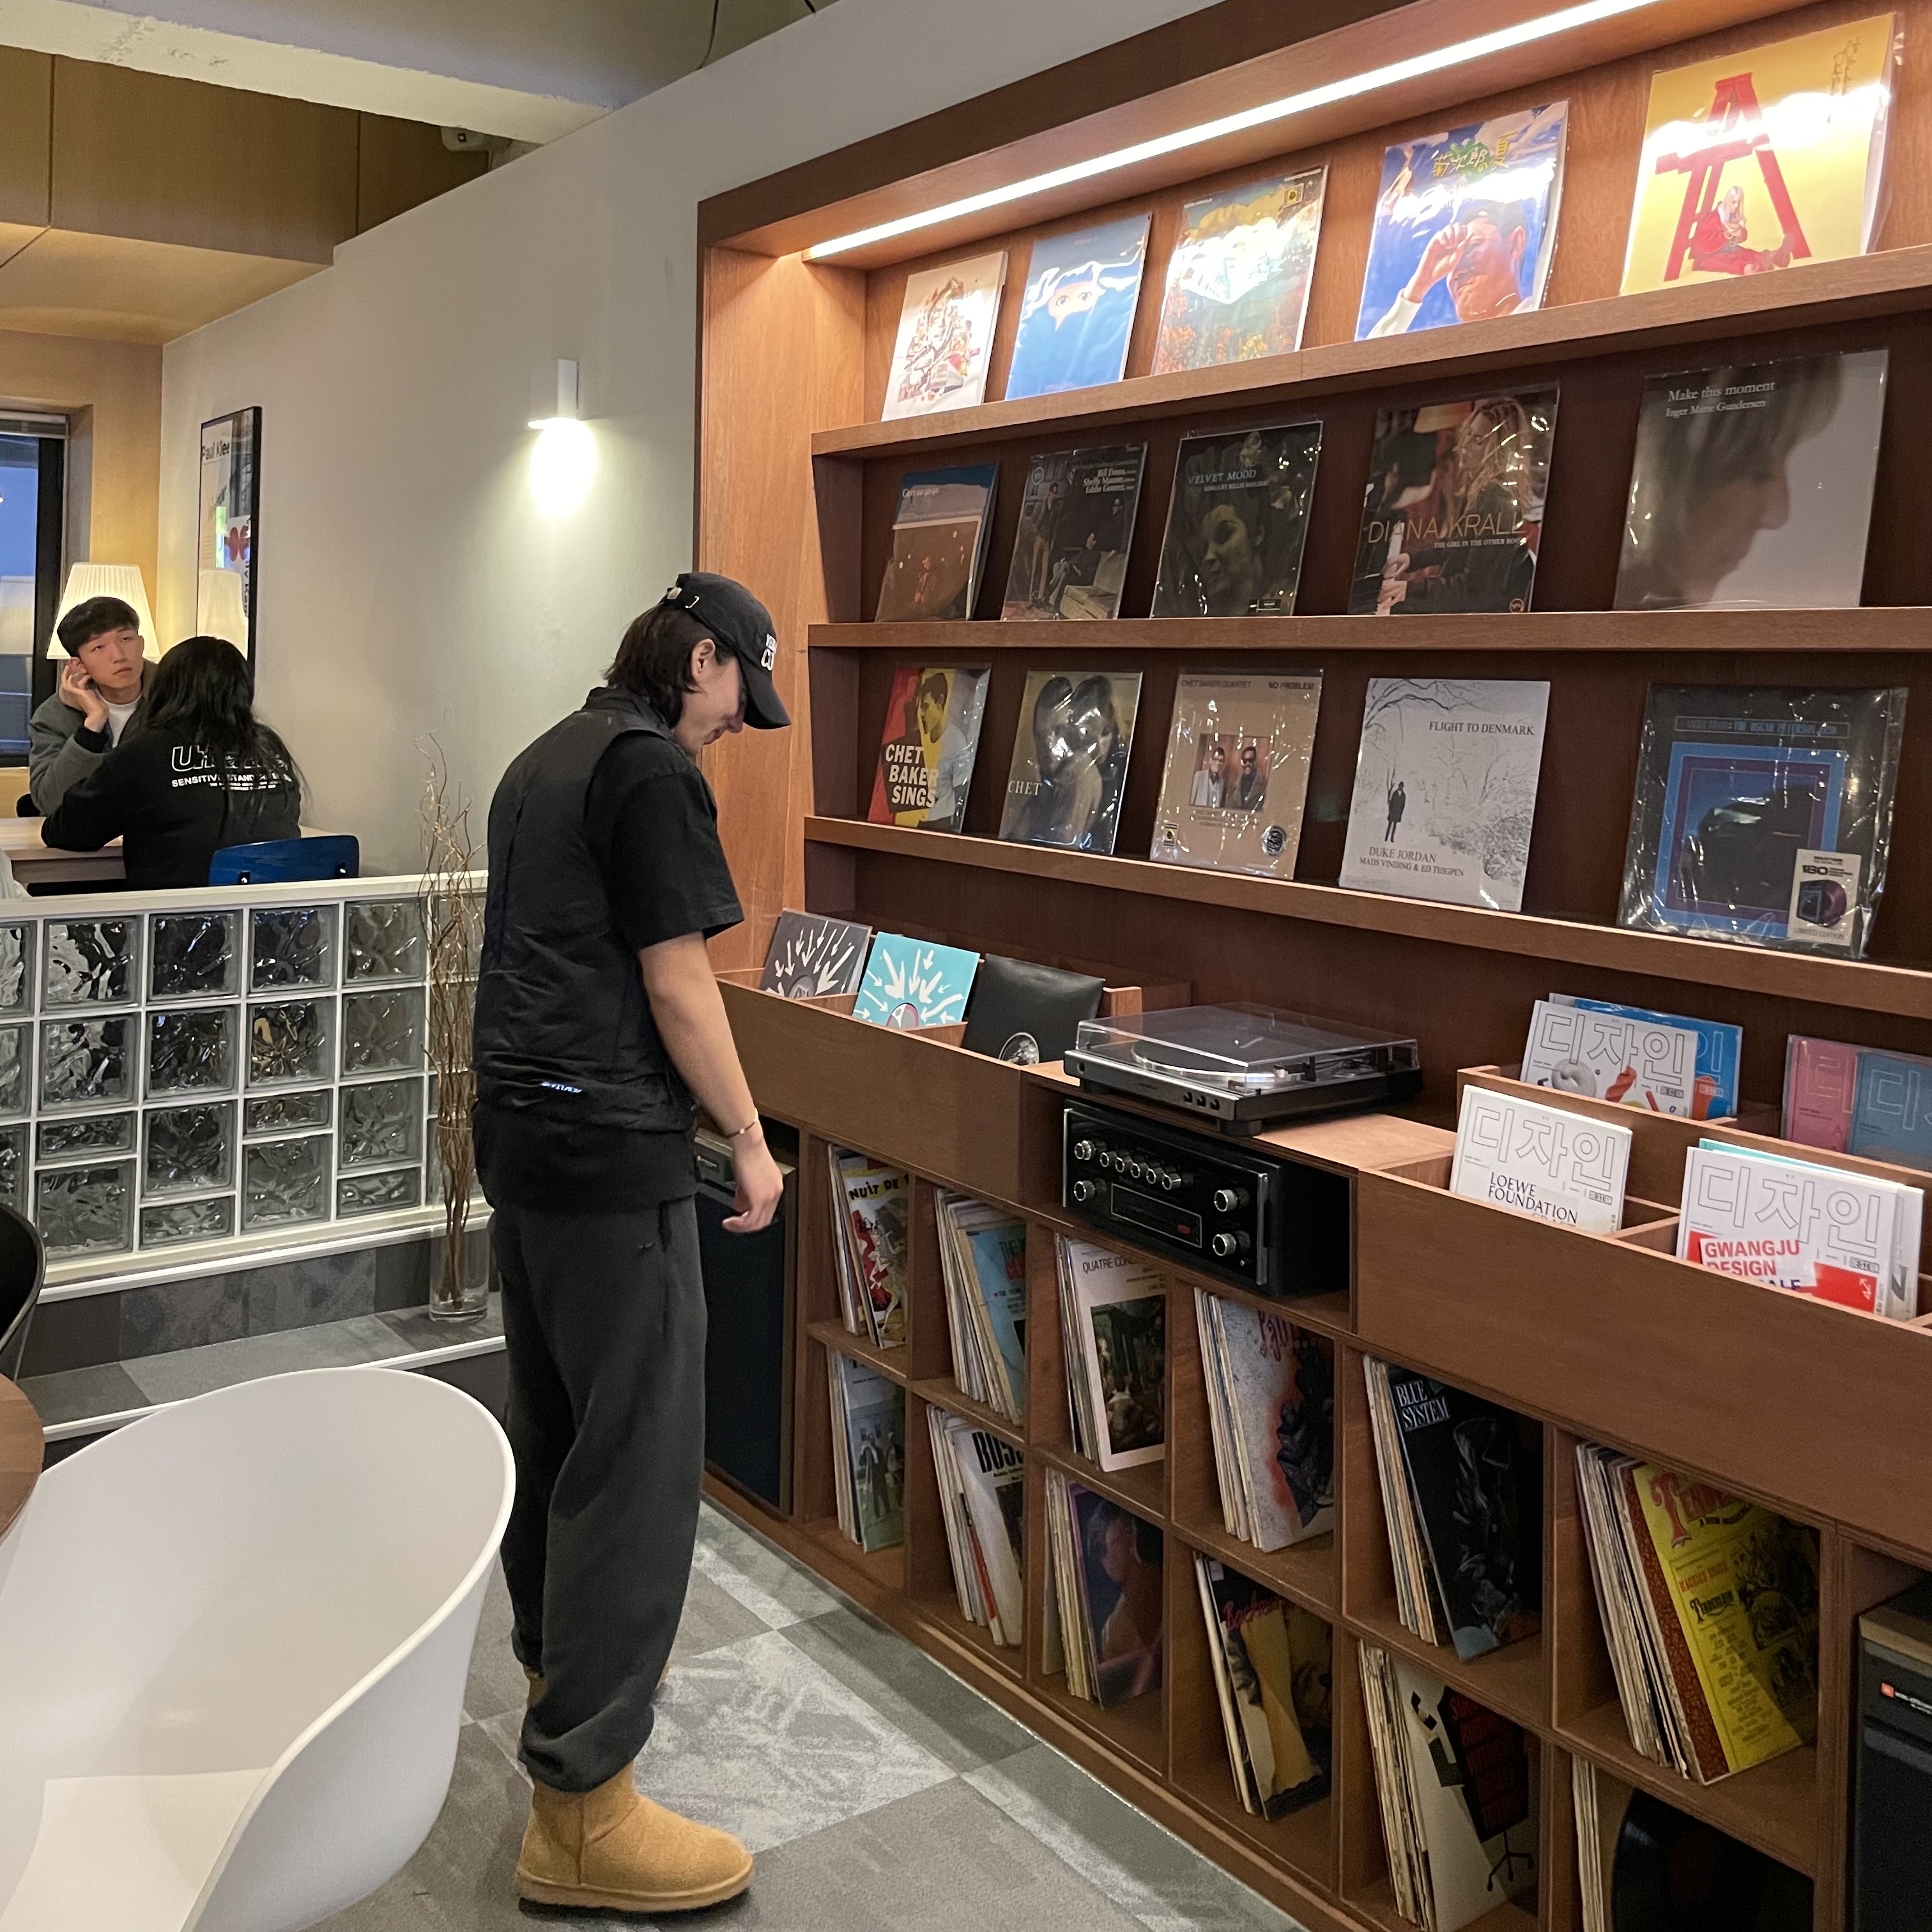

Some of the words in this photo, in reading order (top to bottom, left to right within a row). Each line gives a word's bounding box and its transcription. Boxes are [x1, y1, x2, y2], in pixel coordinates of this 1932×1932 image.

[1667, 390, 1698, 402] Make
[1701, 386, 1722, 398] this
[1724, 381, 1775, 395] moment
[1717, 401, 1766, 411] Gundersen
[202, 443, 215, 460] Paul
[216, 440, 229, 456] Klee
[1188, 473, 1224, 484] VELVET
[1227, 470, 1257, 480] MOOD
[1368, 517, 1438, 543] DIANA
[1447, 512, 1526, 537] KRALL
[1506, 537, 1526, 546] ROO
[1280, 682, 1315, 690] PROBLEM
[1429, 721, 1464, 732] FLIGHT
[1466, 723, 1479, 733] TO
[1481, 723, 1534, 735] DENMARK
[885, 744, 924, 764] CHET
[889, 765, 939, 790] BAKER
[1008, 780, 1042, 795] CHET
[891, 785, 936, 808] SINGS
[1369, 847, 1395, 858] DUKE
[1397, 850, 1437, 862] JORDAN
[1360, 857, 1380, 866] MADS
[1381, 859, 1411, 871] VINDING
[1421, 864, 1431, 873] ED
[1433, 866, 1464, 876] THIGPEN
[1540, 1013, 1685, 1085] 디자인
[1472, 1107, 1615, 1192] 디자인
[884, 1179, 899, 1190] DE
[1490, 1172, 1537, 1197] LOEWE
[1489, 1185, 1577, 1223] FOUNDATION
[1698, 1165, 1881, 1259] 디자인
[1705, 1239, 1800, 1259] GWANGJU
[1082, 1257, 1113, 1274] QUATRE
[1395, 1380, 1428, 1407] BLUE
[1402, 1397, 1450, 1429] SYSTEM
